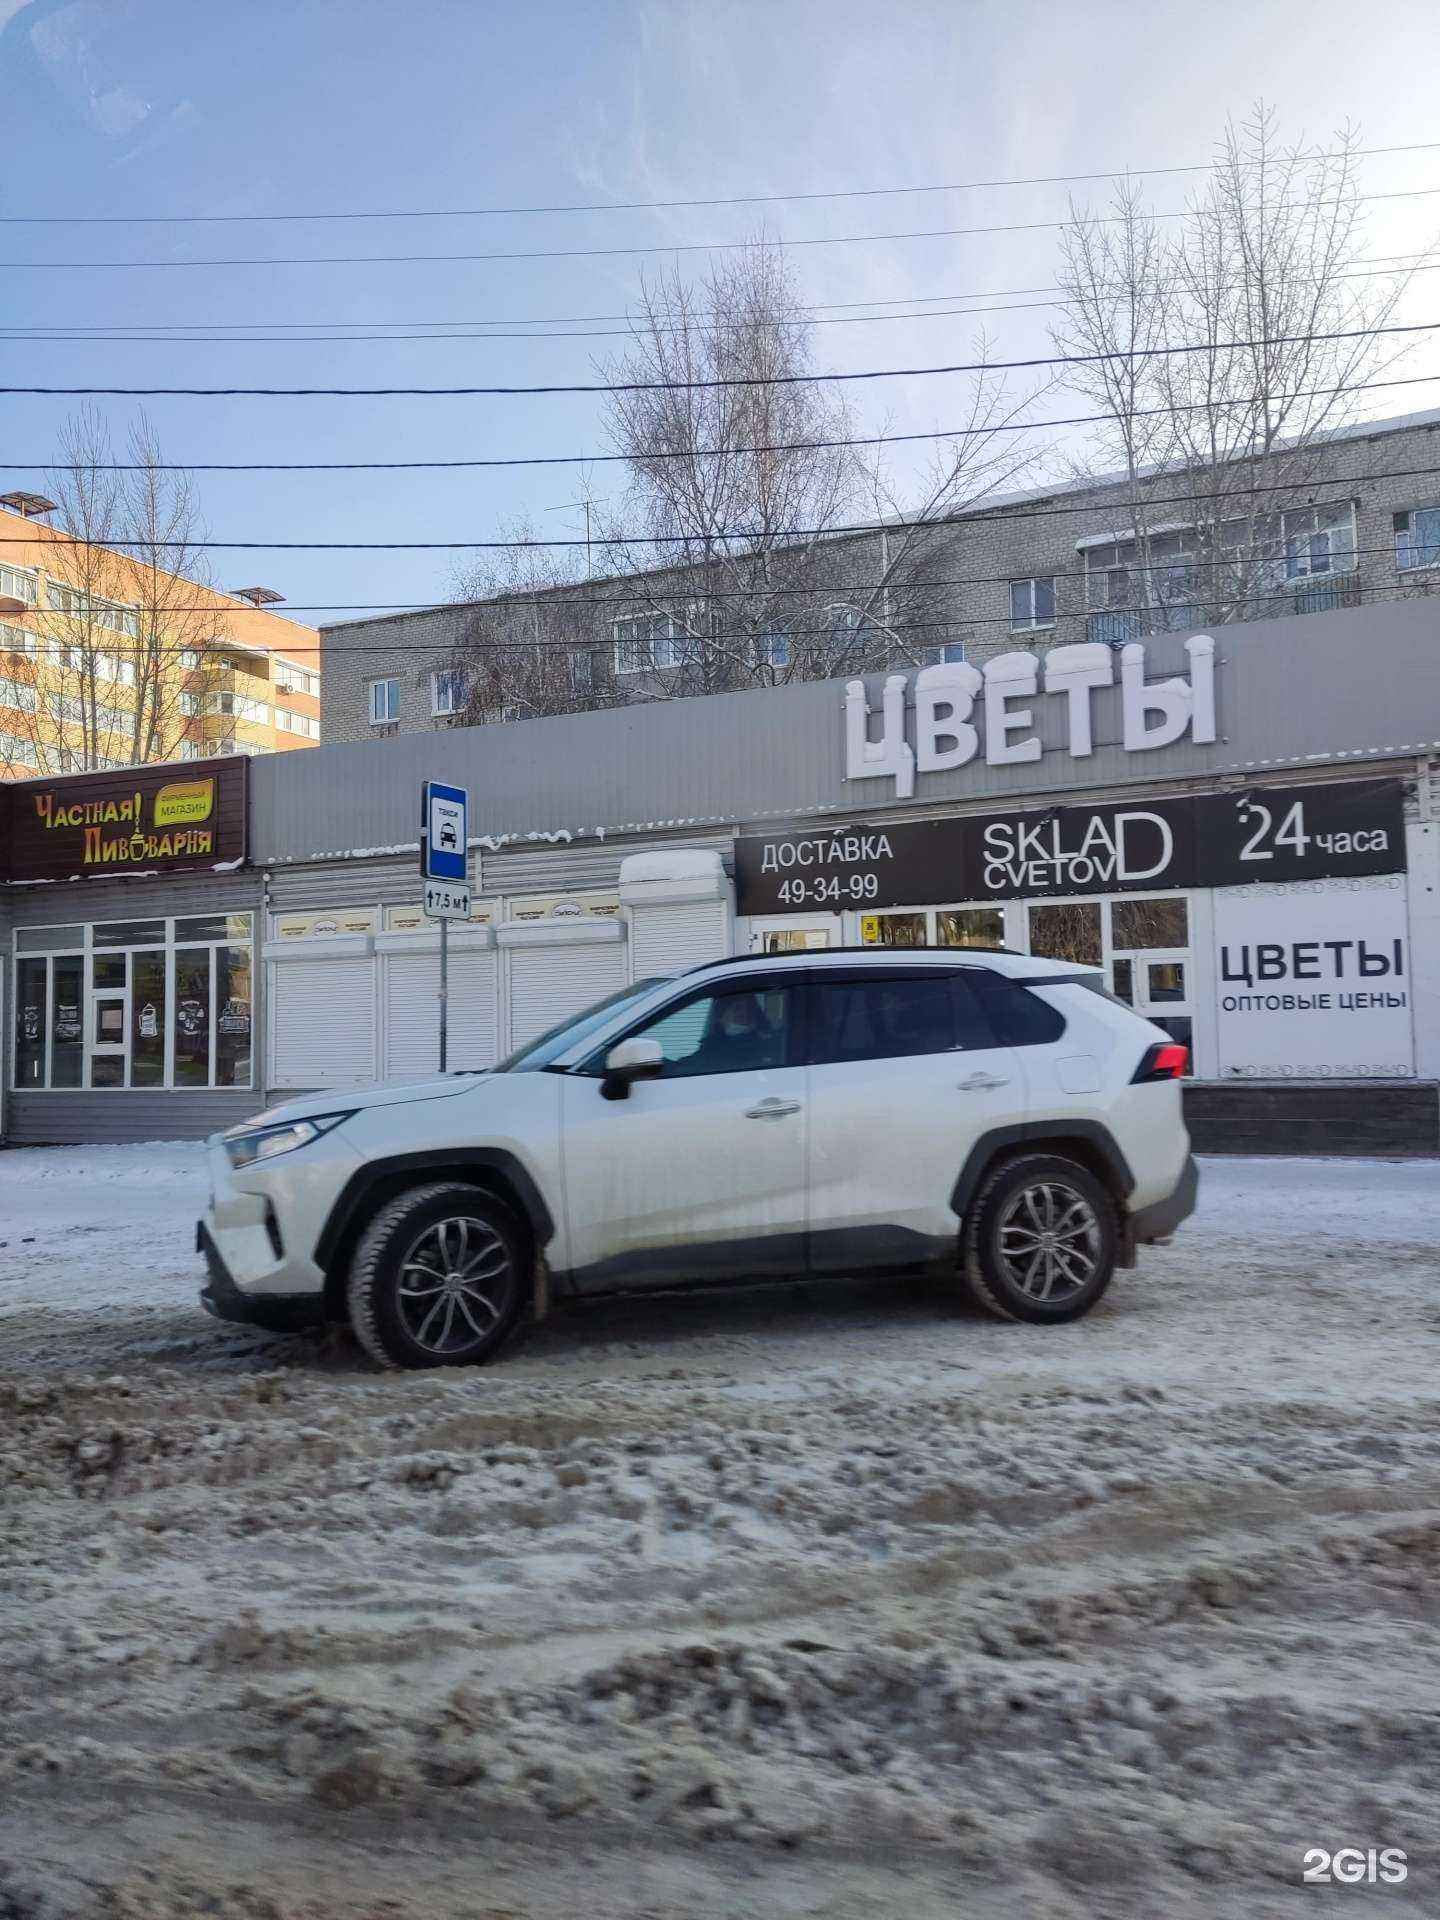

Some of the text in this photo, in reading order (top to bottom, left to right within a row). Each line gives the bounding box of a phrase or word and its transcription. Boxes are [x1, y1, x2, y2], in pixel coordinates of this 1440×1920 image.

[846, 645, 1215, 798] ЦВЕТЫ
[161, 803, 207, 817] МАГАЗИН
[983, 811, 1174, 881] SKLAD
[1237, 800, 1389, 861] 24 часа
[761, 834, 893, 873] ДОСТАВКА
[777, 874, 878, 904] 49-34-99
[984, 856, 1117, 889] CVETOV
[435, 892, 451, 909] 7,5
[1221, 938, 1404, 988] ЦВЕТЫ
[1222, 992, 1407, 1012] ОПТОВЫЕ ЦЕНЫ
